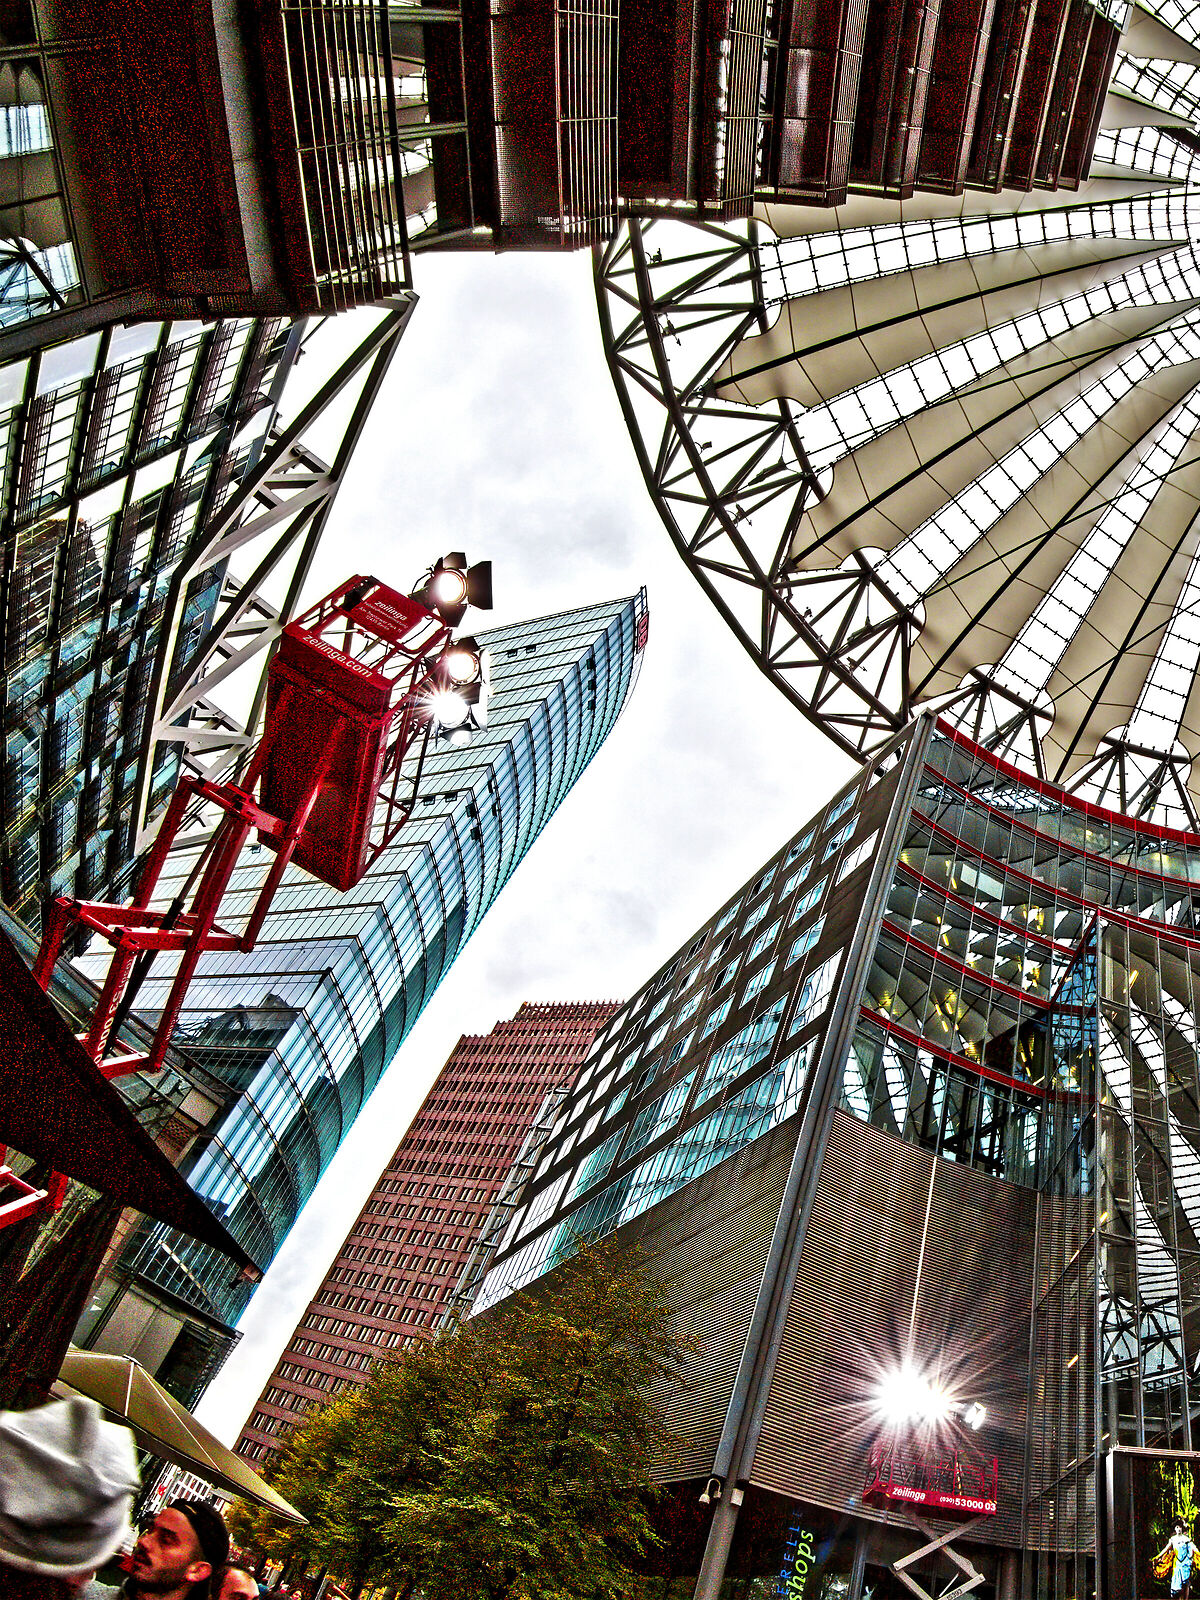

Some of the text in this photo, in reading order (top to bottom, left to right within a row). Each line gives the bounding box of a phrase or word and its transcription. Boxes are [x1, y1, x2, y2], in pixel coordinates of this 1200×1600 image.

[374, 600, 408, 622] zeilinga
[302, 634, 373, 678] zeilinga.com
[892, 1487, 926, 1501] zeilinga
[984, 1502, 997, 1511] 03
[786, 1529, 817, 1600] shops
